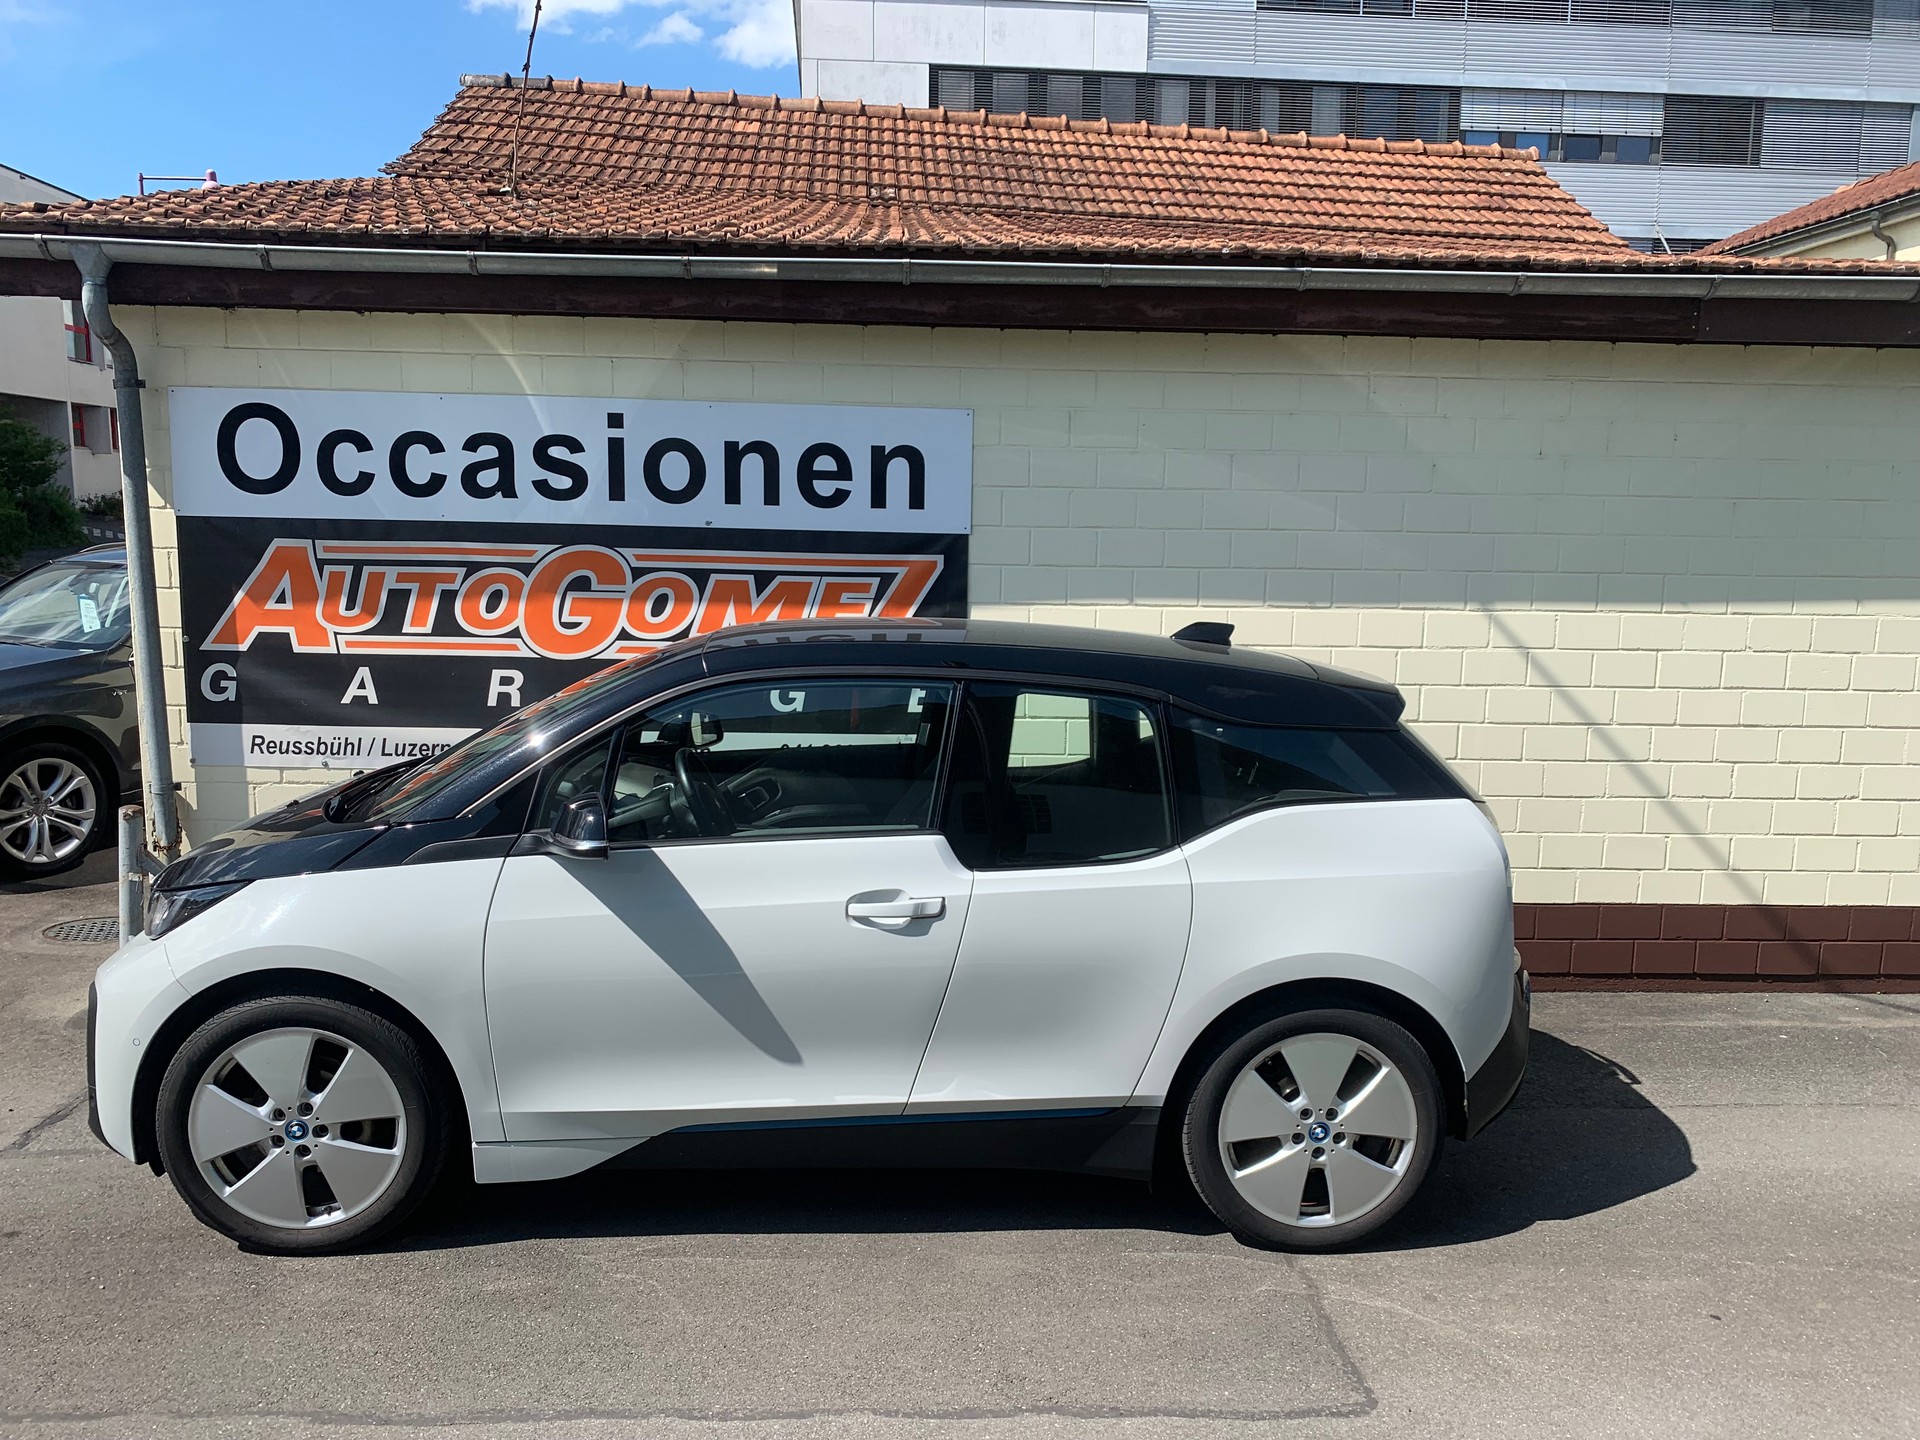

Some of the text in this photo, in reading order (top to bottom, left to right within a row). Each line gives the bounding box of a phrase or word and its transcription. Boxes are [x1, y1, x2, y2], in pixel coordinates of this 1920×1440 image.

[216, 402, 927, 510] Occasionen
[250, 734, 362, 757] Reussbühl
[367, 737, 376, 757] /
